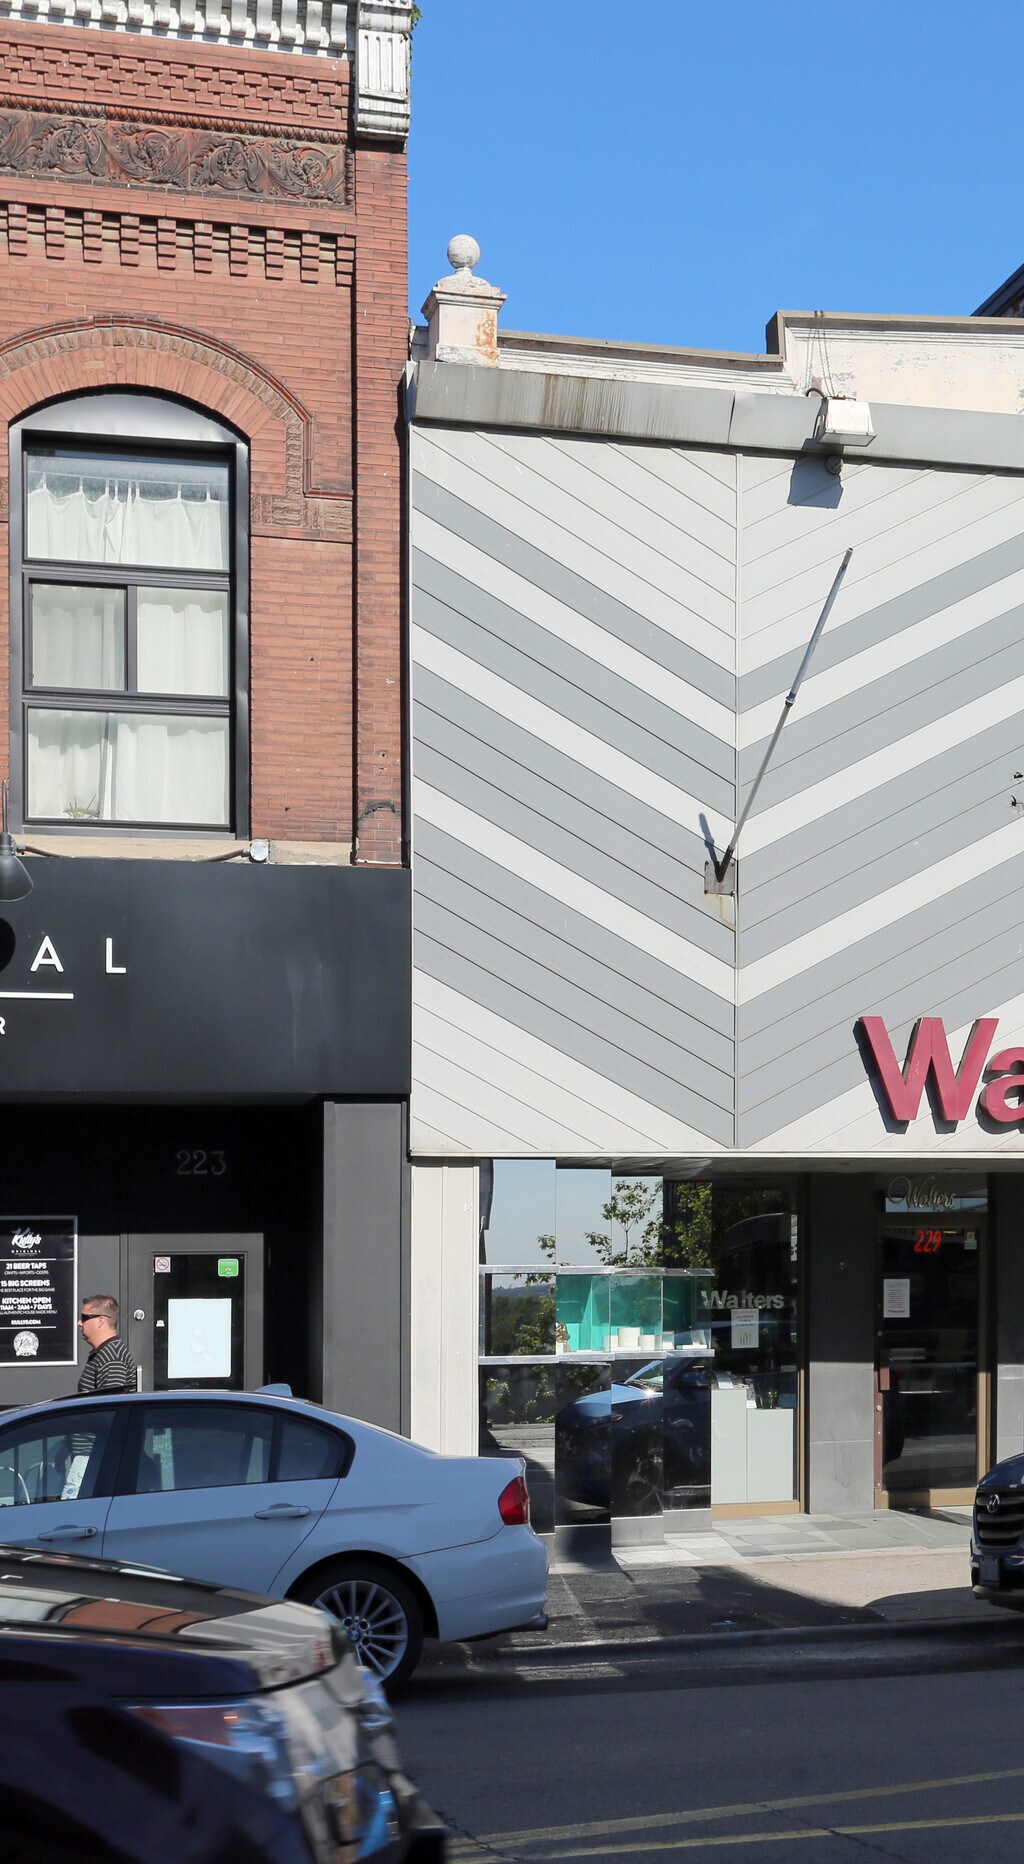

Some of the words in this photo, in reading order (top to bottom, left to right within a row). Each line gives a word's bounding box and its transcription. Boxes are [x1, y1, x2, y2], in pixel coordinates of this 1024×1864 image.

[176, 1150, 227, 1175] 223
[887, 1175, 957, 1210] Walters
[11, 1228, 42, 1249] Kully's
[914, 1230, 942, 1252] 229
[701, 1290, 785, 1309] Walters
